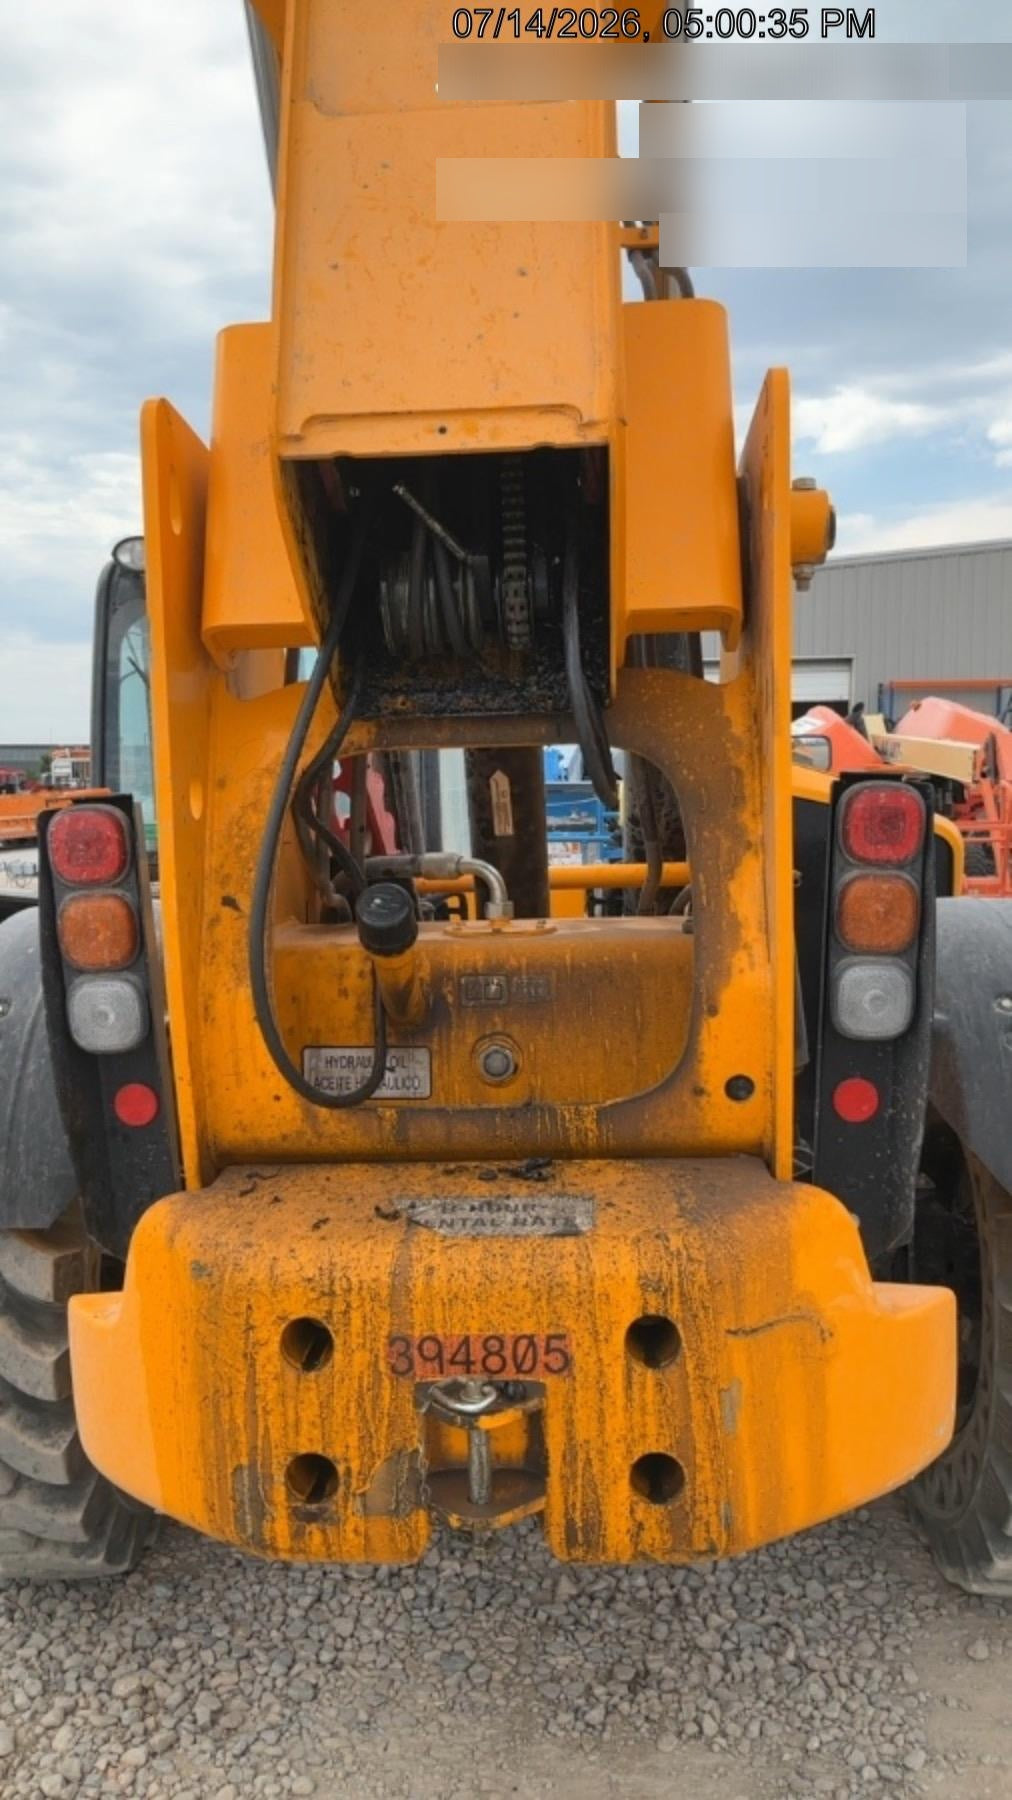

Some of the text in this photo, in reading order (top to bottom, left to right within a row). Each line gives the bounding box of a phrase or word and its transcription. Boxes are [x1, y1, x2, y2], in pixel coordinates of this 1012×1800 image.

[325, 1055, 408, 1069] HYDRAU OIL
[314, 1075, 350, 1091] ACEITE
[389, 1333, 570, 1376] 394805
